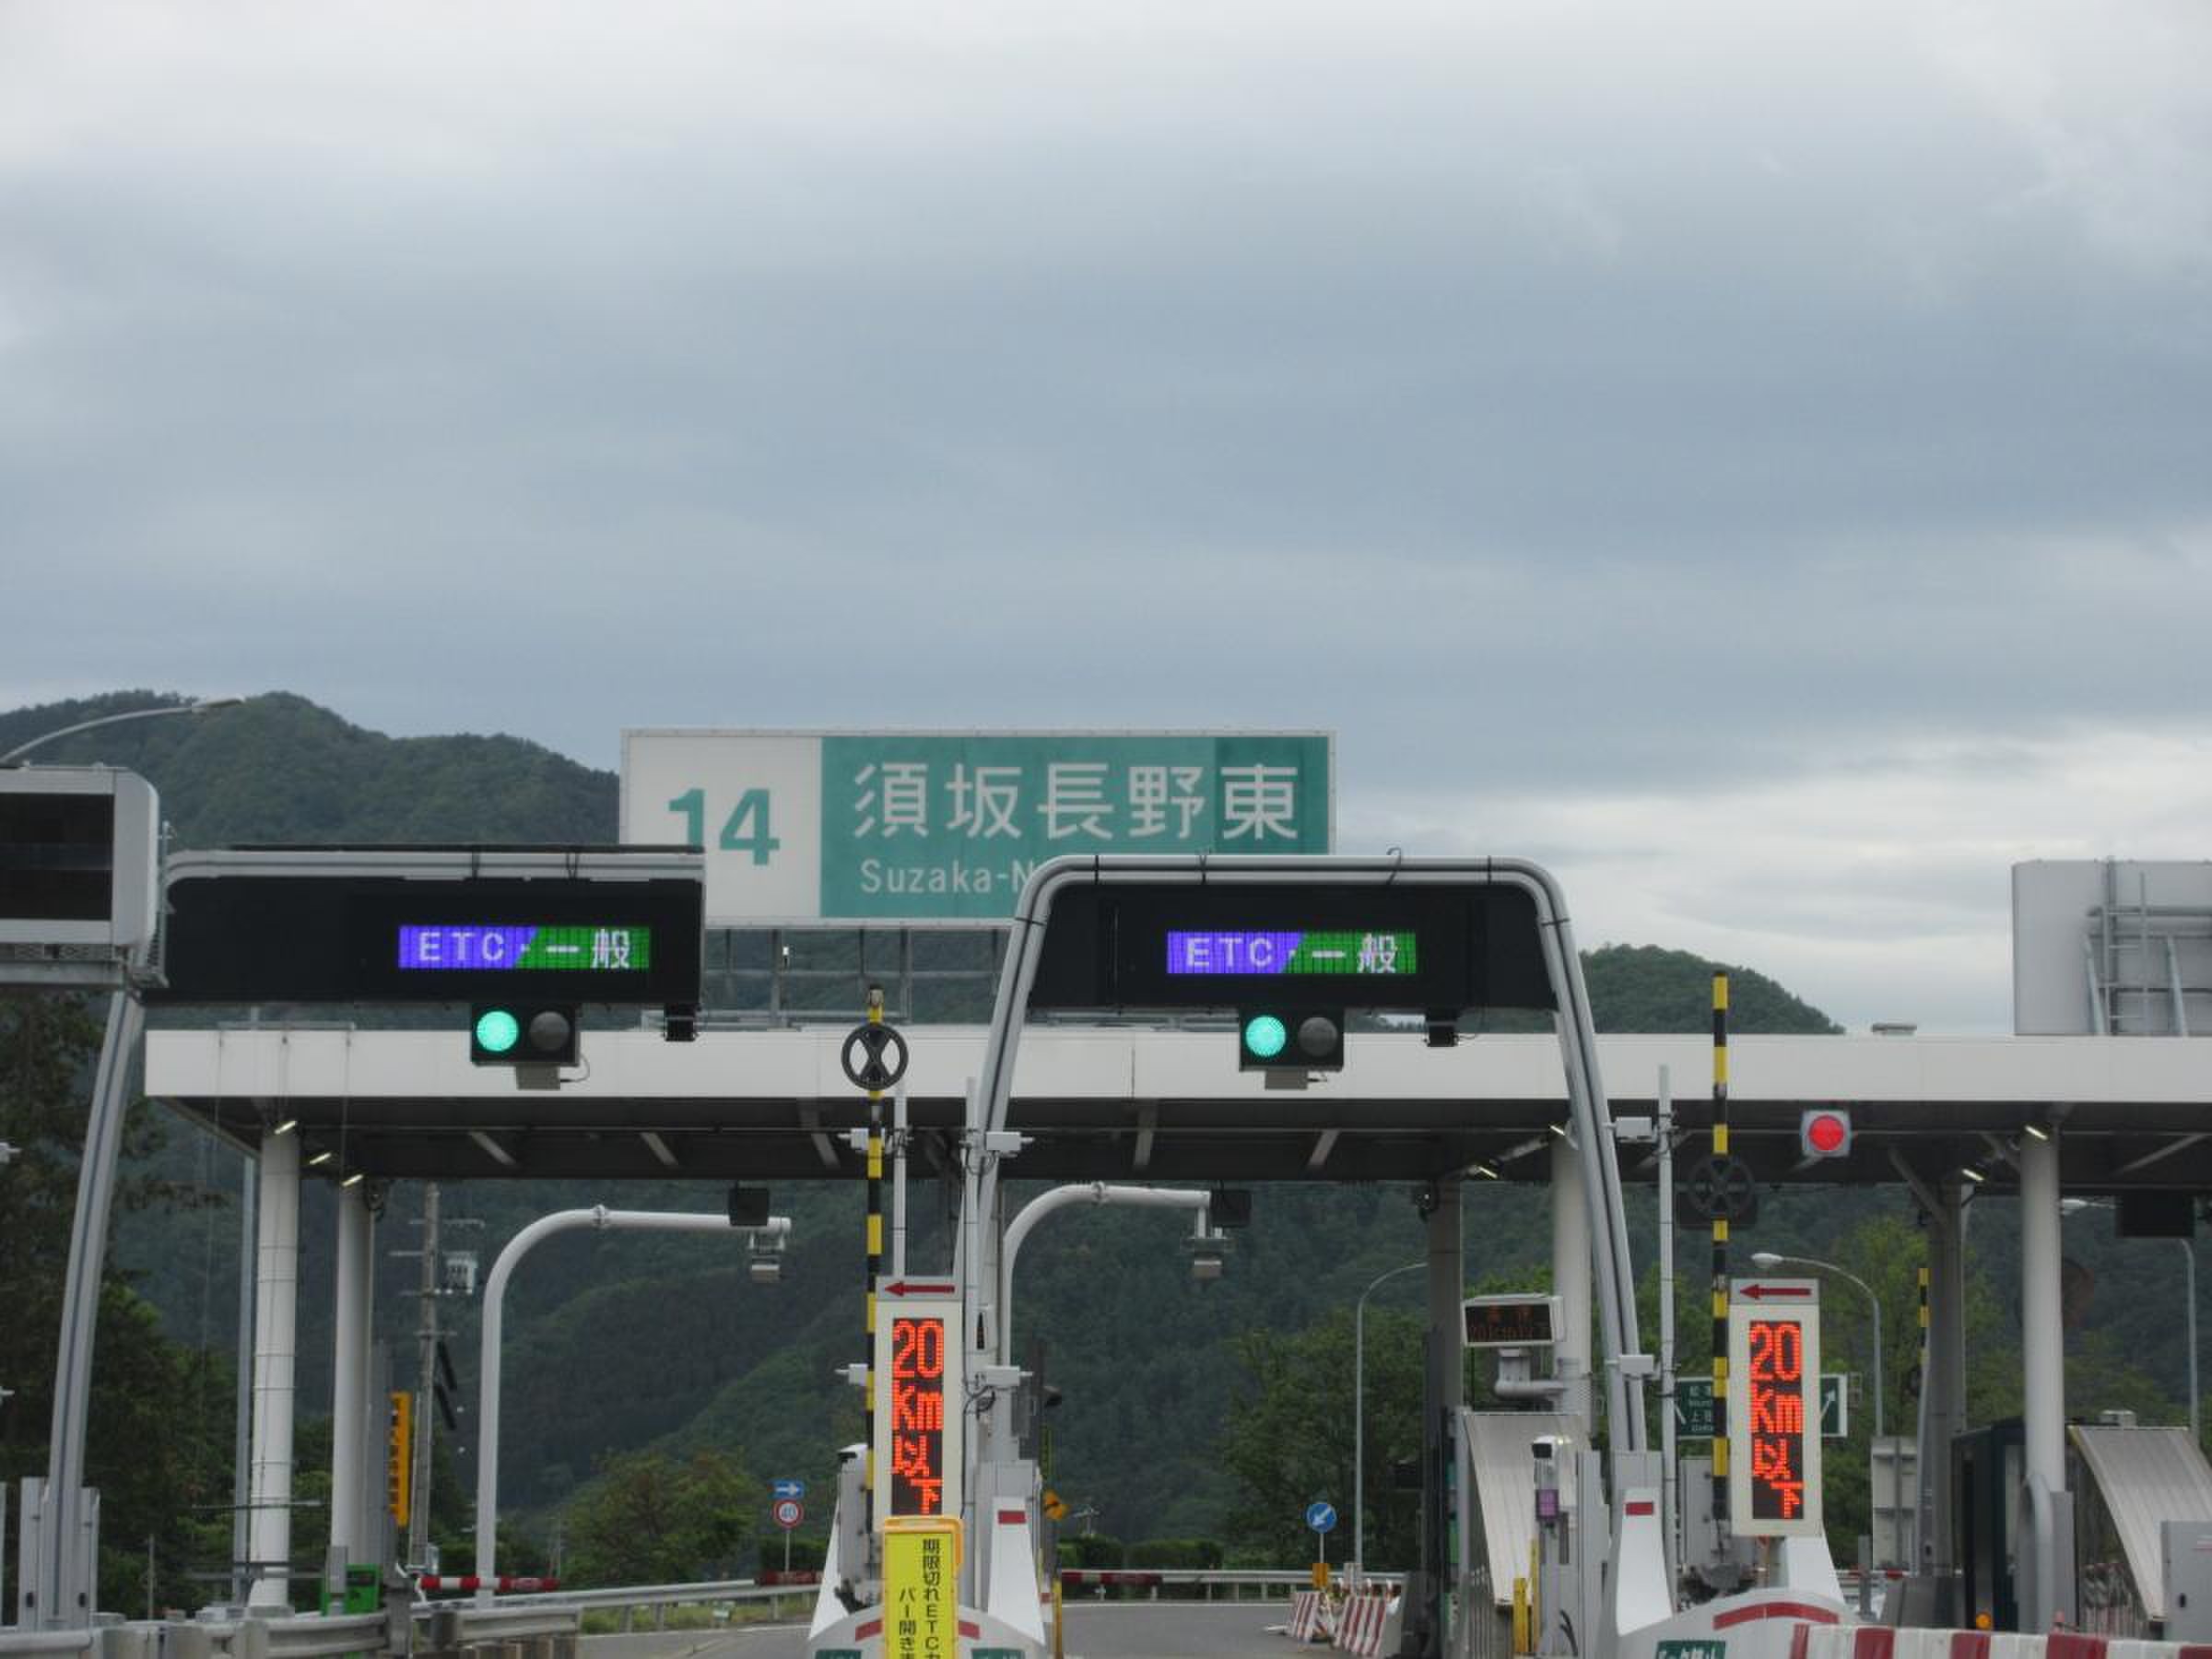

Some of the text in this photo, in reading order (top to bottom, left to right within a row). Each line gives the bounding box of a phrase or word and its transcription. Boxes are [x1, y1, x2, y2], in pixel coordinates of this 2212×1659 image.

[668, 788, 782, 865] 14
[854, 762, 1299, 840] 須坂長野東
[892, 1319, 944, 1378] 20
[1749, 1323, 1803, 1380] 20
[890, 1434, 943, 1514] 以下
[1752, 1438, 1805, 1518] 以下
